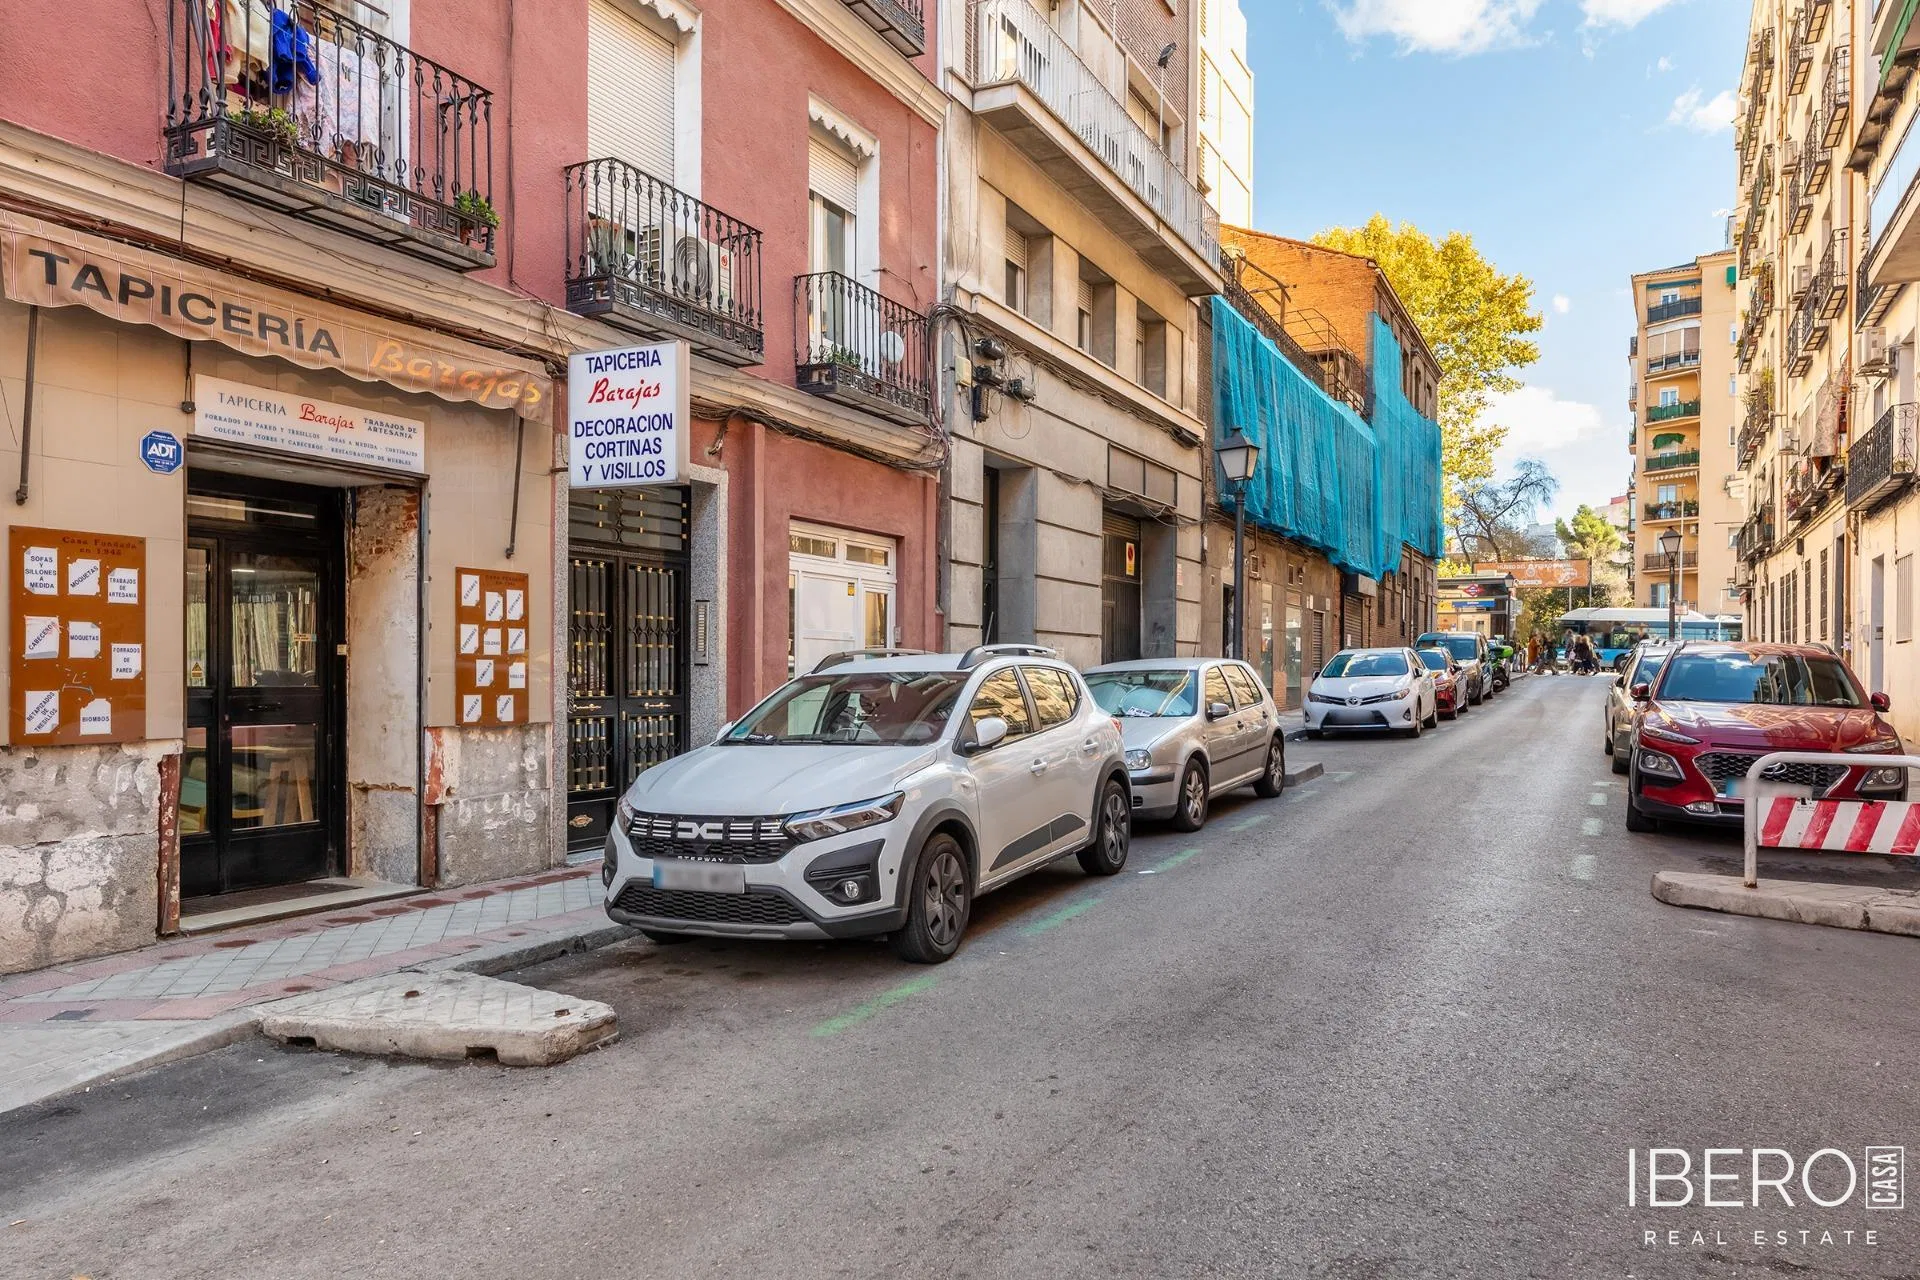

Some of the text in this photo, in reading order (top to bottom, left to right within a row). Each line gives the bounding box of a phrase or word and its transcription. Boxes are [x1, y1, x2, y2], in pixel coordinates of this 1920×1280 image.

[28, 248, 542, 403] TAPICERÍA Barajas
[585, 349, 661, 374] TAPICERIA
[588, 377, 661, 410] Barajas
[204, 413, 241, 425] FORRADOS
[256, 422, 277, 431] PARED
[218, 392, 355, 434] TAPICERIA Barajas
[364, 417, 404, 431] TRABAJOS
[213, 426, 245, 437] COLCHAS
[254, 433, 277, 442] STORES
[367, 426, 413, 439] ARTESANIA
[575, 413, 673, 438] DECORACION
[148, 443, 176, 459] ADT
[355, 441, 378, 450] MEDIDA
[585, 437, 662, 460] CORTINAS
[583, 459, 666, 482] Y VISILLOS
[25, 568, 57, 576] SILLONES
[70, 565, 99, 588] MOQUETAS
[109, 577, 137, 585] TRABAJOS
[26, 691, 55, 722] RETAPIZADOS
[41, 708, 49, 716] DE
[34, 708, 58, 733] TRESILLOS
